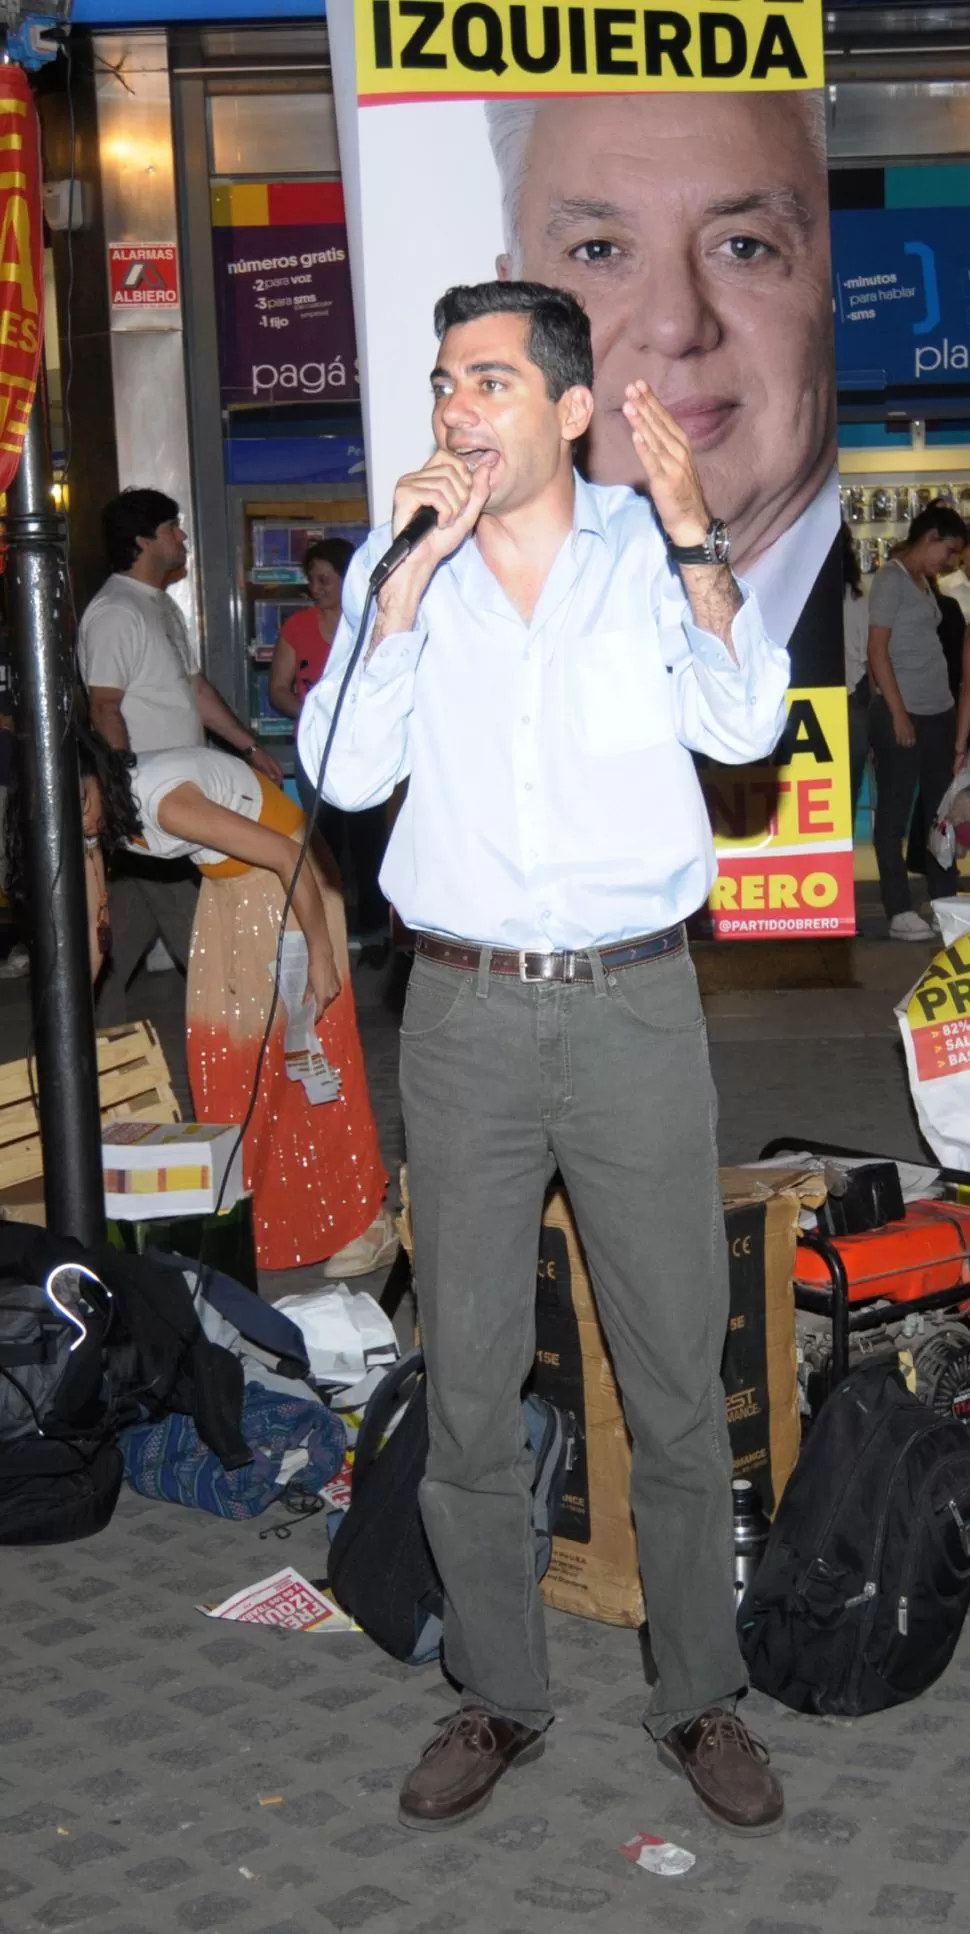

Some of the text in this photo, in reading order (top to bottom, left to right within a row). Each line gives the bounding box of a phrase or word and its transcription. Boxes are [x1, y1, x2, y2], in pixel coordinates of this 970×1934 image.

[372, 0, 808, 79] IZQUIERDA
[112, 249, 174, 260] ALARMAS
[228, 248, 345, 274] números gratis
[291, 274, 312, 285] voz
[114, 290, 177, 303] ALBIERO
[293, 294, 317, 305] sms
[849, 286, 916, 307] para hablar
[269, 316, 290, 330] fijo
[914, 337, 970, 378] pla
[252, 354, 346, 396] pagá
[718, 917, 840, 933] @PARTIDOOBRERO
